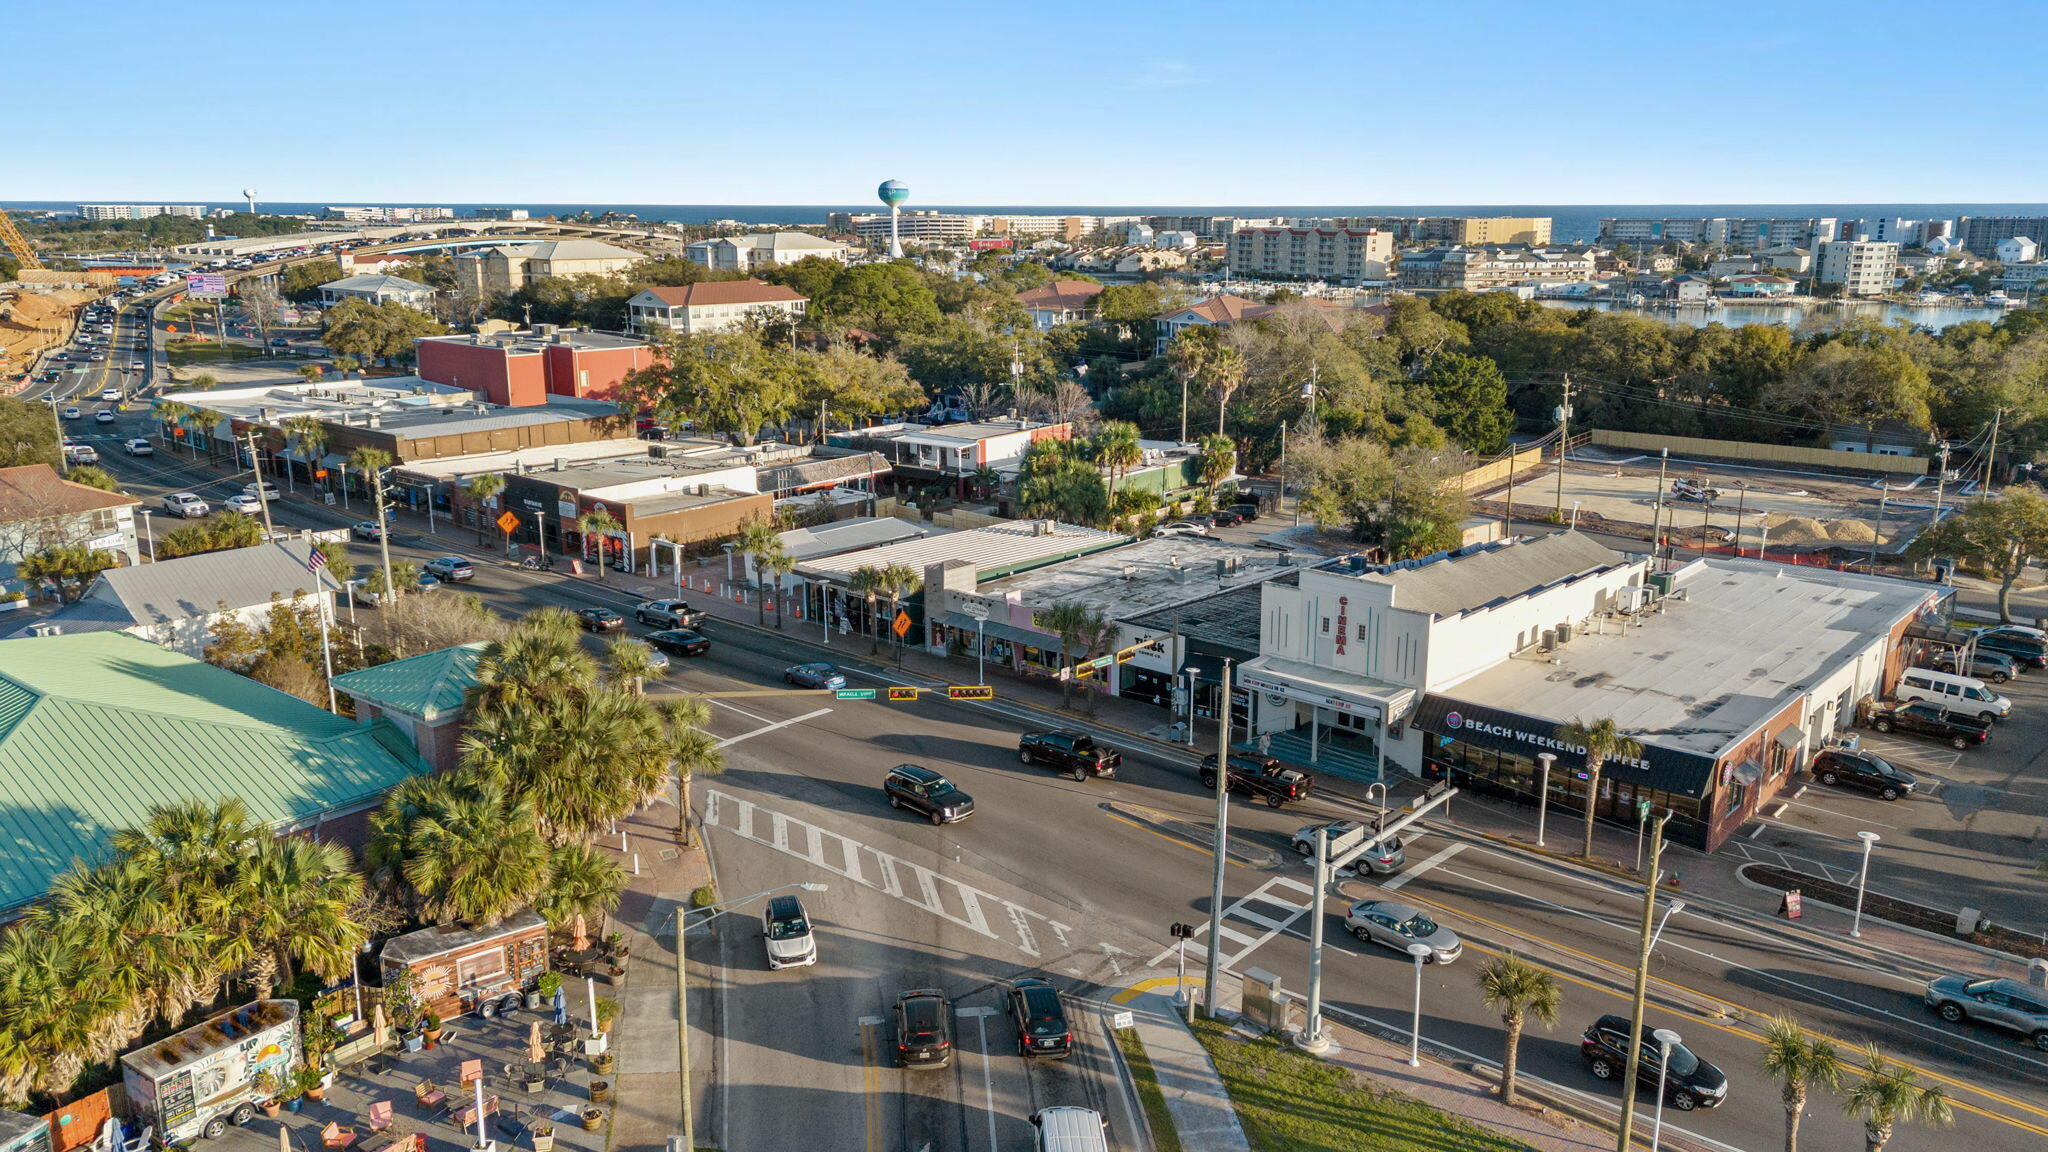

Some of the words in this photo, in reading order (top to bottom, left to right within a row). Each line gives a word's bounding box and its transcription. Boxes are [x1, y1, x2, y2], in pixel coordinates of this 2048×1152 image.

[1336, 596, 1348, 655] CINEMA
[1465, 719, 1512, 738] BEACH
[1515, 730, 1587, 755] WEEKEND
[1601, 748, 1650, 771] OFFEE
